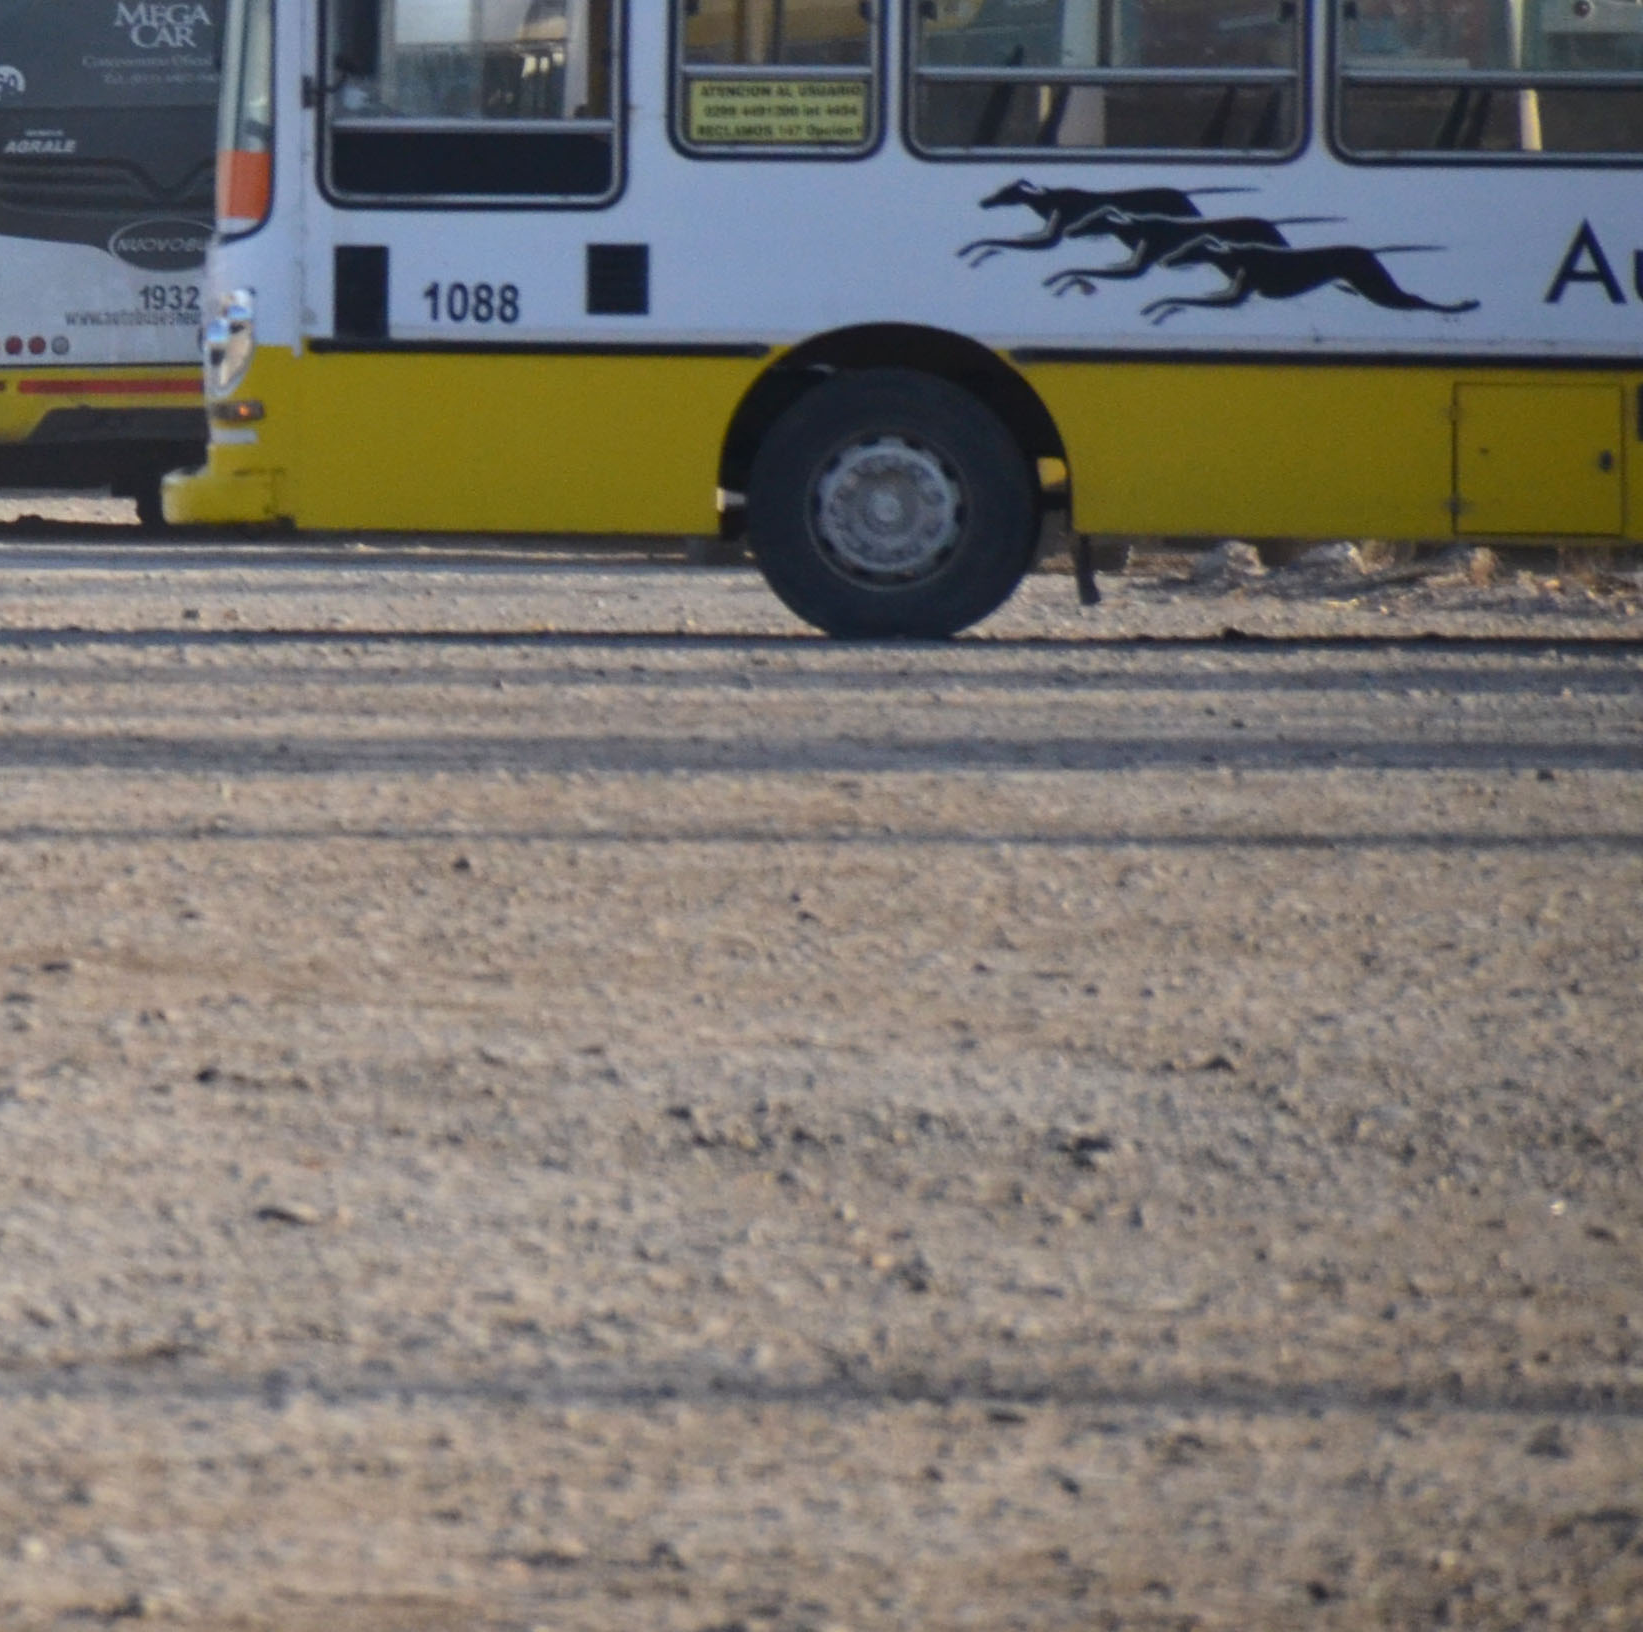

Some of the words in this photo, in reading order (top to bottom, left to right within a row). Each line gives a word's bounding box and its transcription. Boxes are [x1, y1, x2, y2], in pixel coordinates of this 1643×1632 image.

[114, 1, 213, 26] MEGA
[130, 24, 197, 48] CAR
[3, 139, 76, 154] AGRALE
[1543, 217, 1643, 305] A
[139, 284, 200, 311] 1932
[423, 282, 520, 323] 1088
